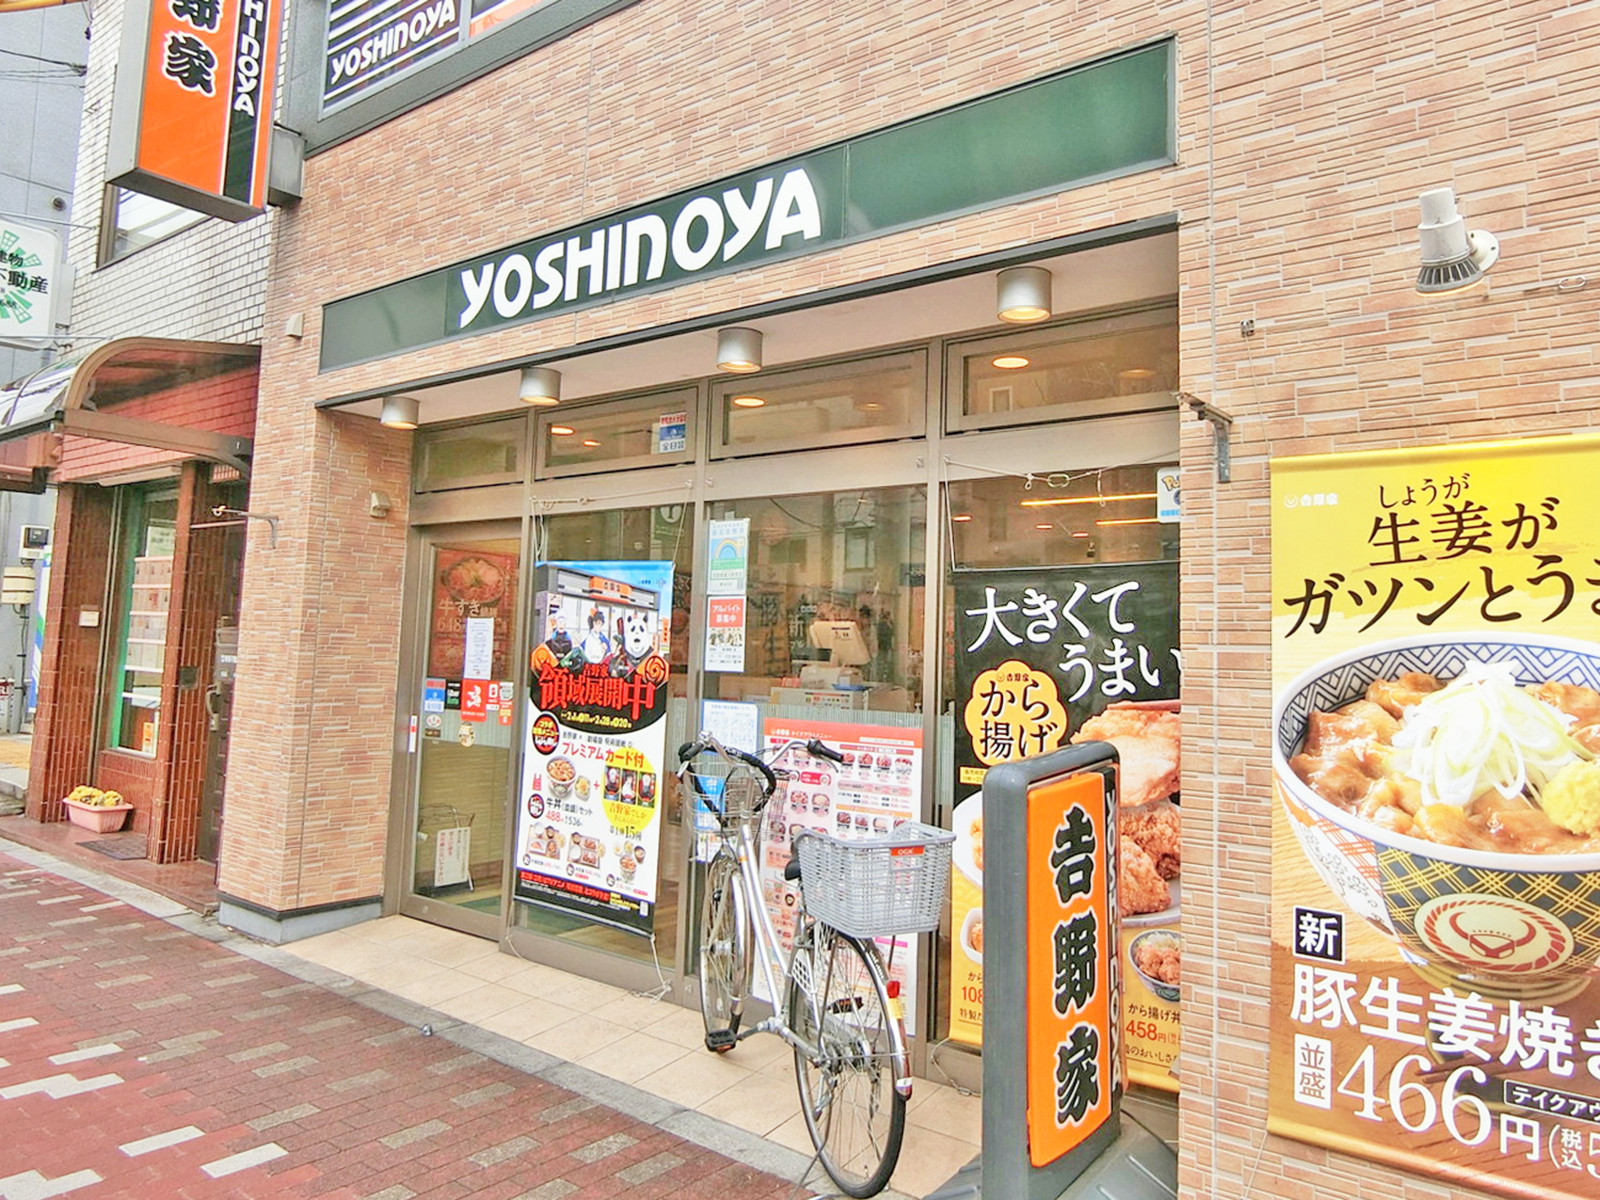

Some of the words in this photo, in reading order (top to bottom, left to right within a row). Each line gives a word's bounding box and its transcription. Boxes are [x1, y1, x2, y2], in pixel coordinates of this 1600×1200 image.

[331, 0, 456, 85] YOSHINOYA
[459, 167, 822, 328] YOSHINOYA
[1379, 472, 1471, 509] しょうが
[1367, 496, 1560, 566] 生姜が
[965, 580, 1140, 653] 大きくて
[539, 664, 656, 721] 領域展開中
[1058, 638, 1181, 703] うまい
[979, 680, 1051, 721] から
[562, 741, 645, 768] プレミアムカード付
[979, 720, 1060, 760] 揚げ
[1299, 914, 1338, 956] 新
[1052, 806, 1097, 1127] 吉野家
[1299, 1042, 1326, 1100] 並盛
